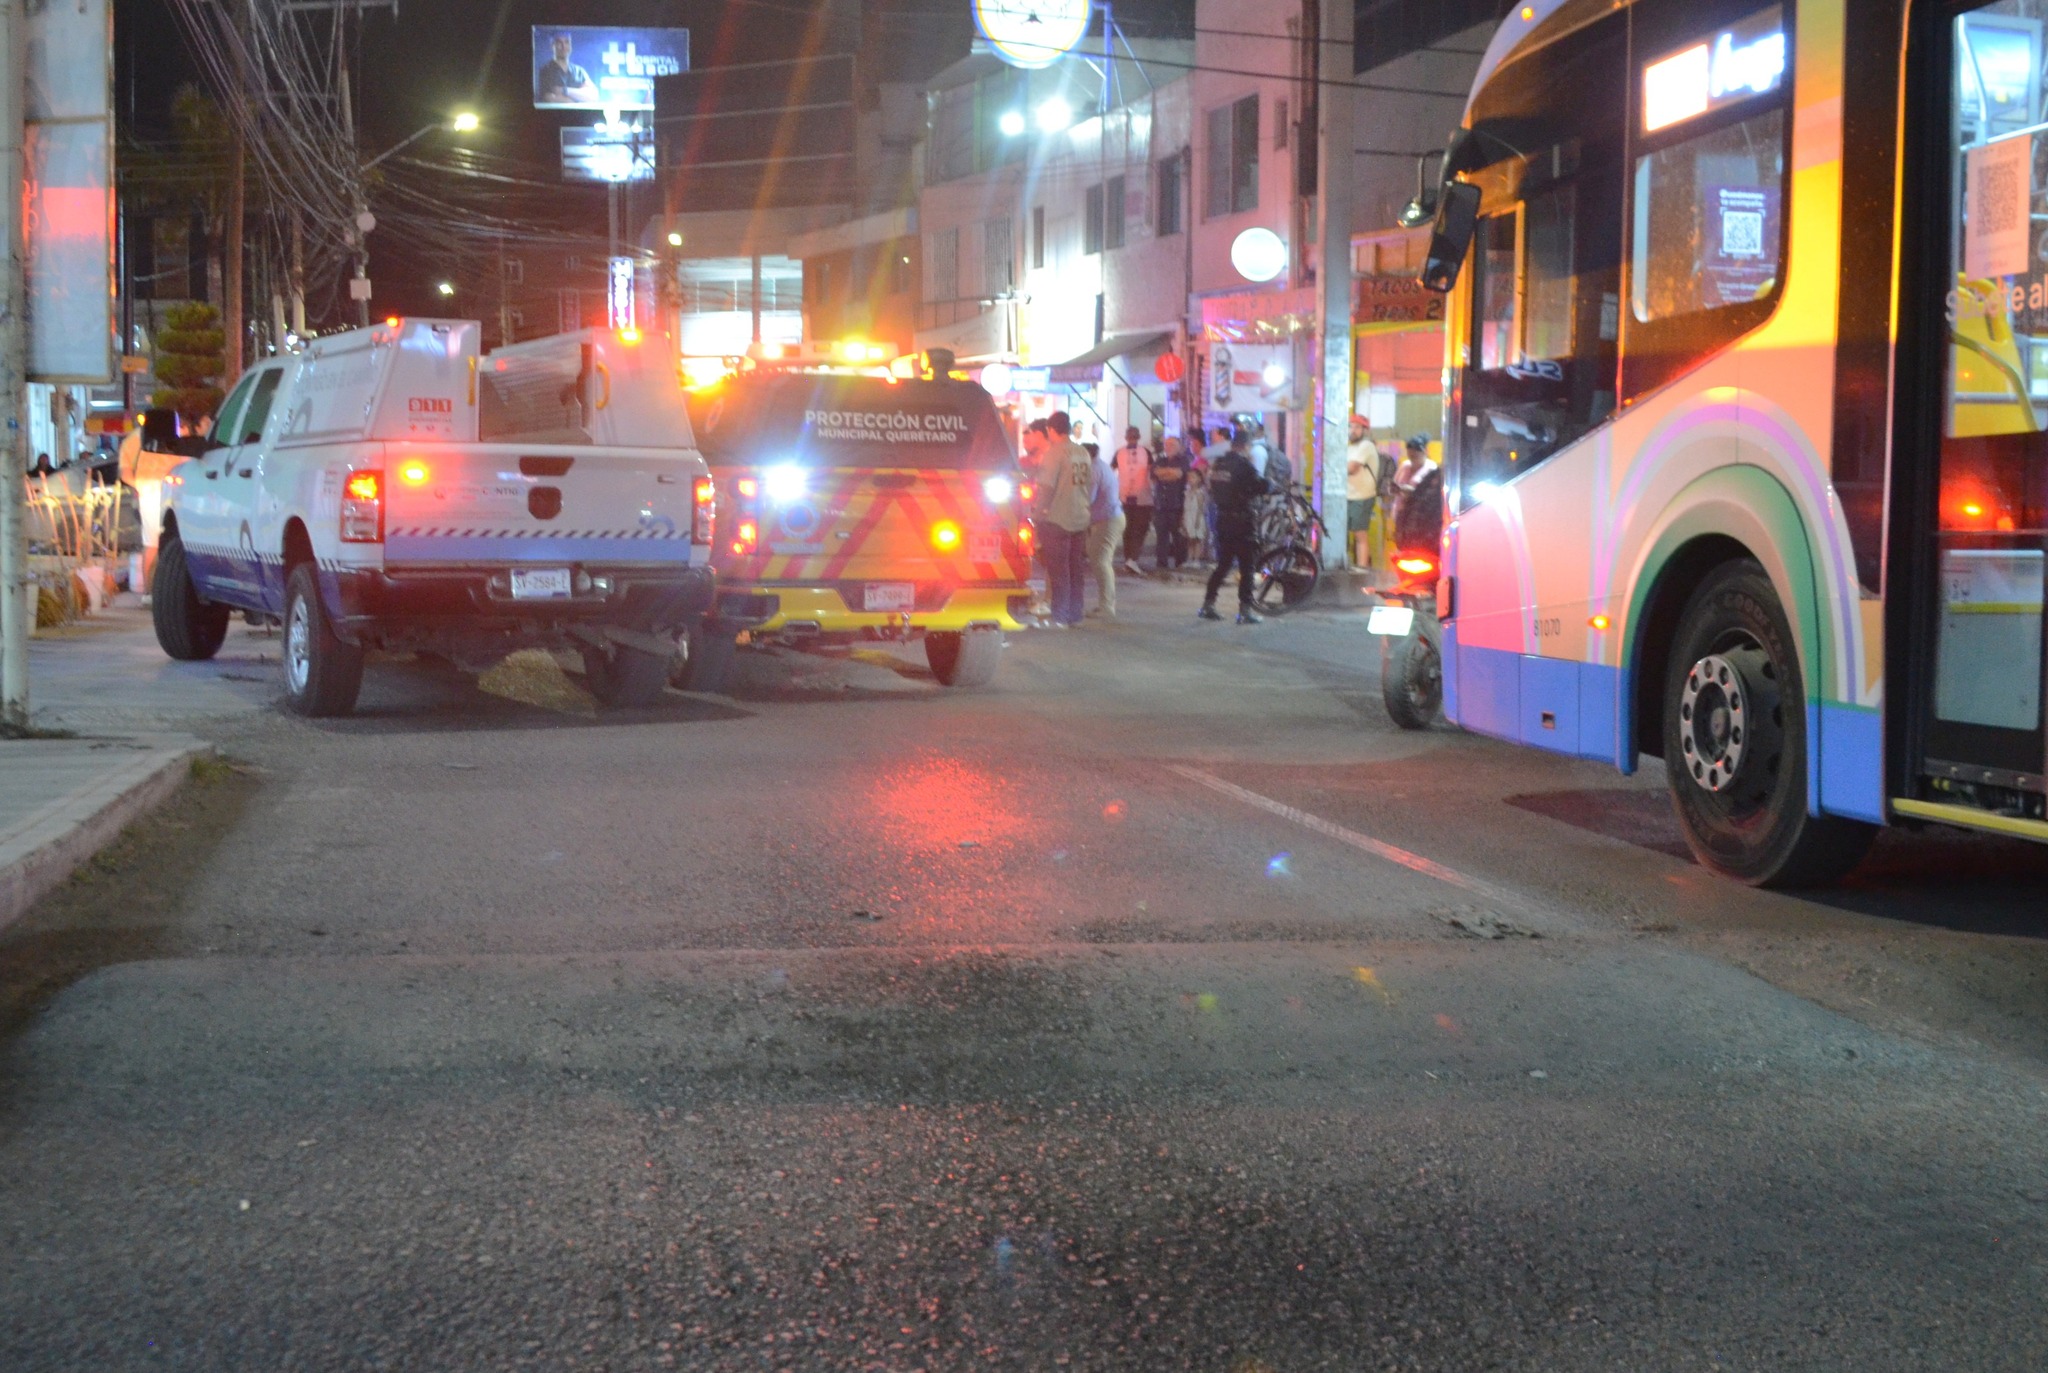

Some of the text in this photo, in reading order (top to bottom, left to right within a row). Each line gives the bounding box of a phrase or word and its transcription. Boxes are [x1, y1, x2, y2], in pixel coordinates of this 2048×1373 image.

[805, 410, 968, 431] PROTECCIÓN CIVIL
[818, 428, 957, 443] MUNICIPAL QUERÉTARO
